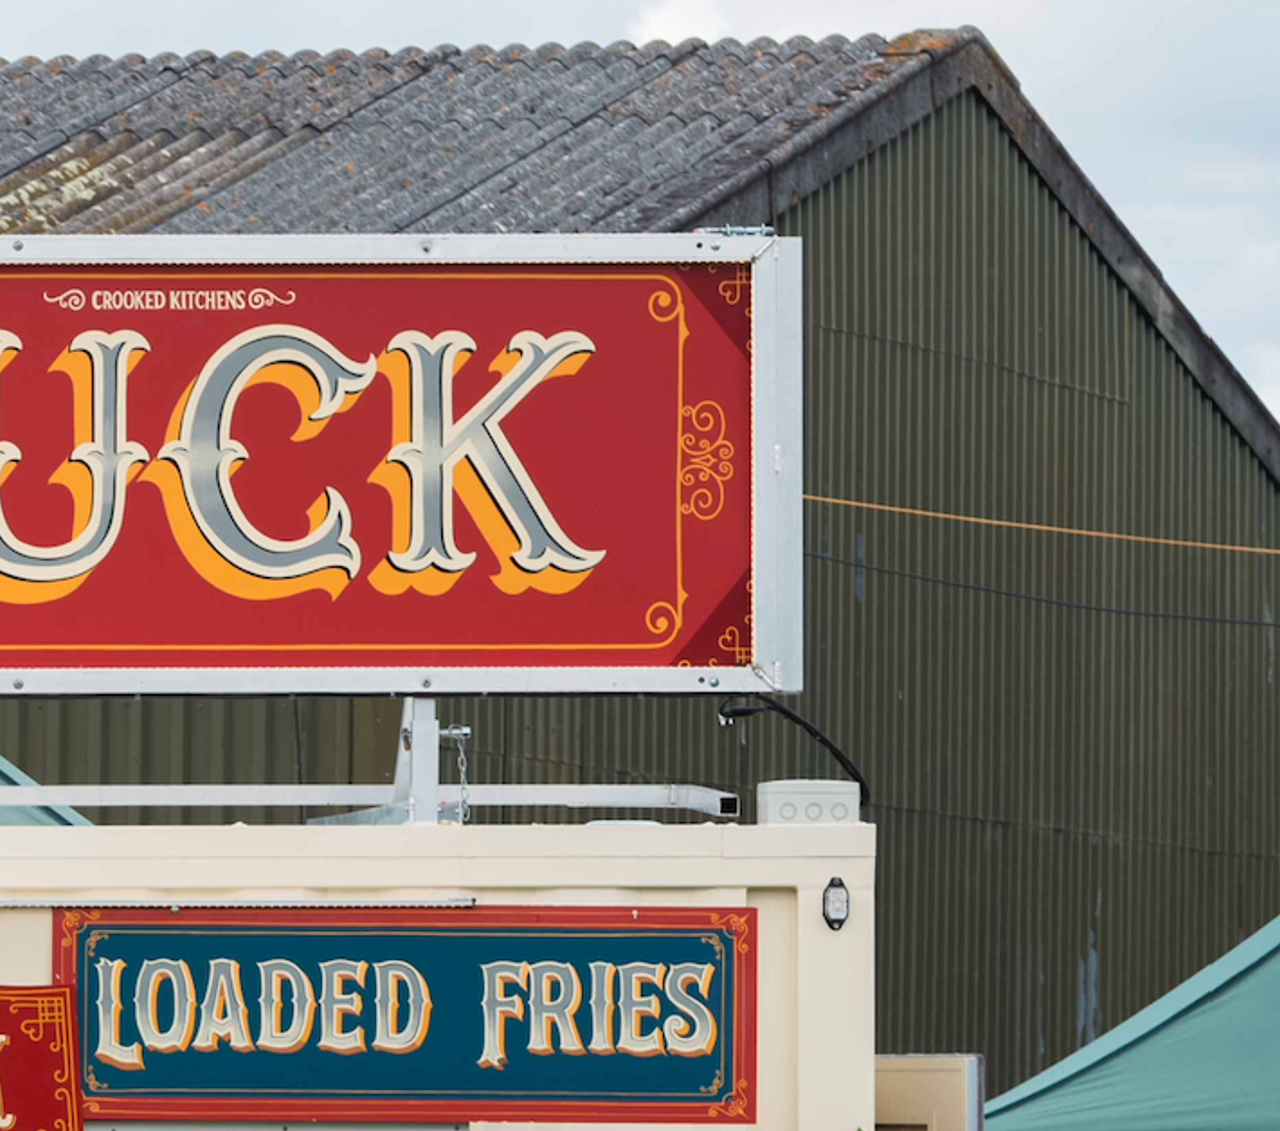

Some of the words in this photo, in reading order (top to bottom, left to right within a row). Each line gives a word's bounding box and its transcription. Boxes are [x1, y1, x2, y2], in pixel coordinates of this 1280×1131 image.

[91, 290, 166, 310] CROOKED
[169, 290, 246, 310] KITCHENS
[94, 957, 432, 1071] LOADED
[478, 961, 717, 1071] FRIES
